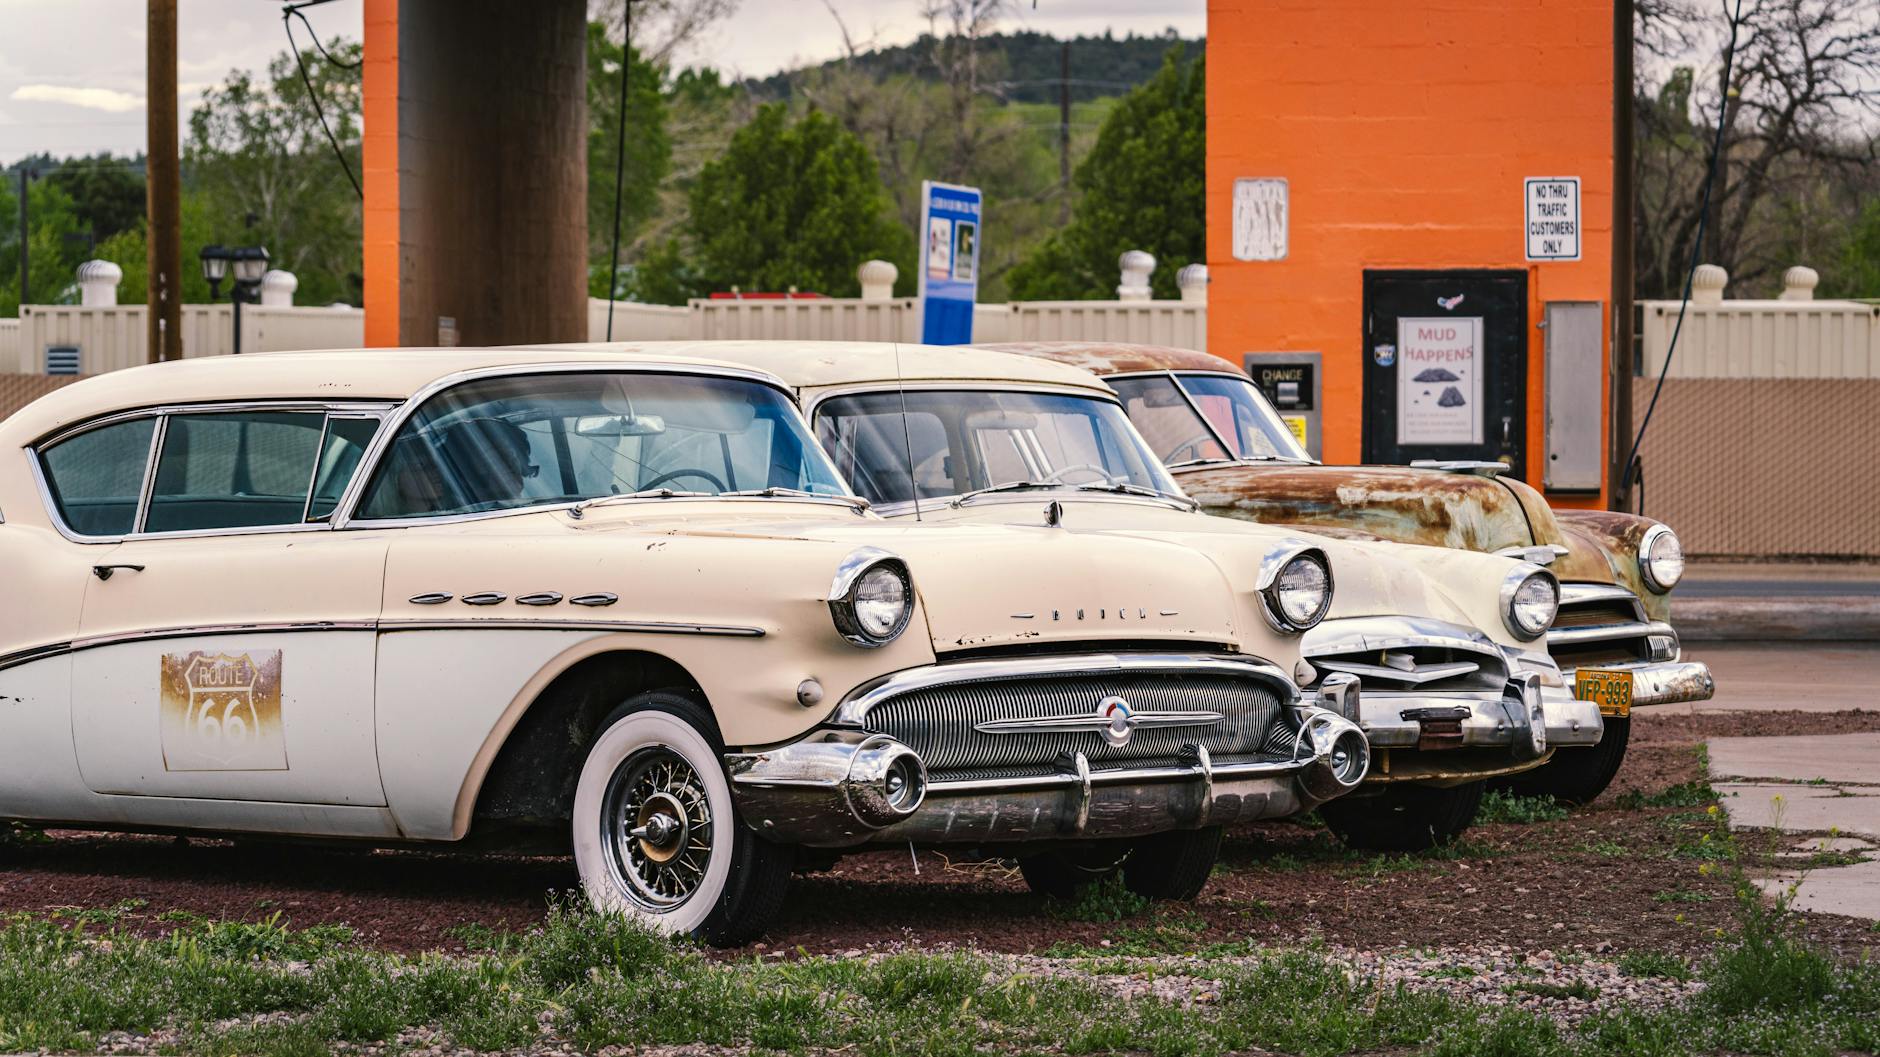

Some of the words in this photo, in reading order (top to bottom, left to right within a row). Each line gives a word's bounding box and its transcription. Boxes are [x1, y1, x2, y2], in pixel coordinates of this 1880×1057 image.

[1536, 185, 1546, 198] NO
[1548, 185, 1568, 198] THRU
[1537, 203, 1567, 216] TRAFFIC
[1530, 221, 1574, 235] CUSTOMERS
[1543, 240, 1562, 254] ONLY
[1418, 327, 1457, 341] MUD
[1405, 345, 1473, 362] HAPPENS
[1262, 369, 1303, 381] CHANGE
[199, 666, 243, 685] ROUTE
[1578, 679, 1629, 705] VFP-993
[198, 698, 247, 742] 66
